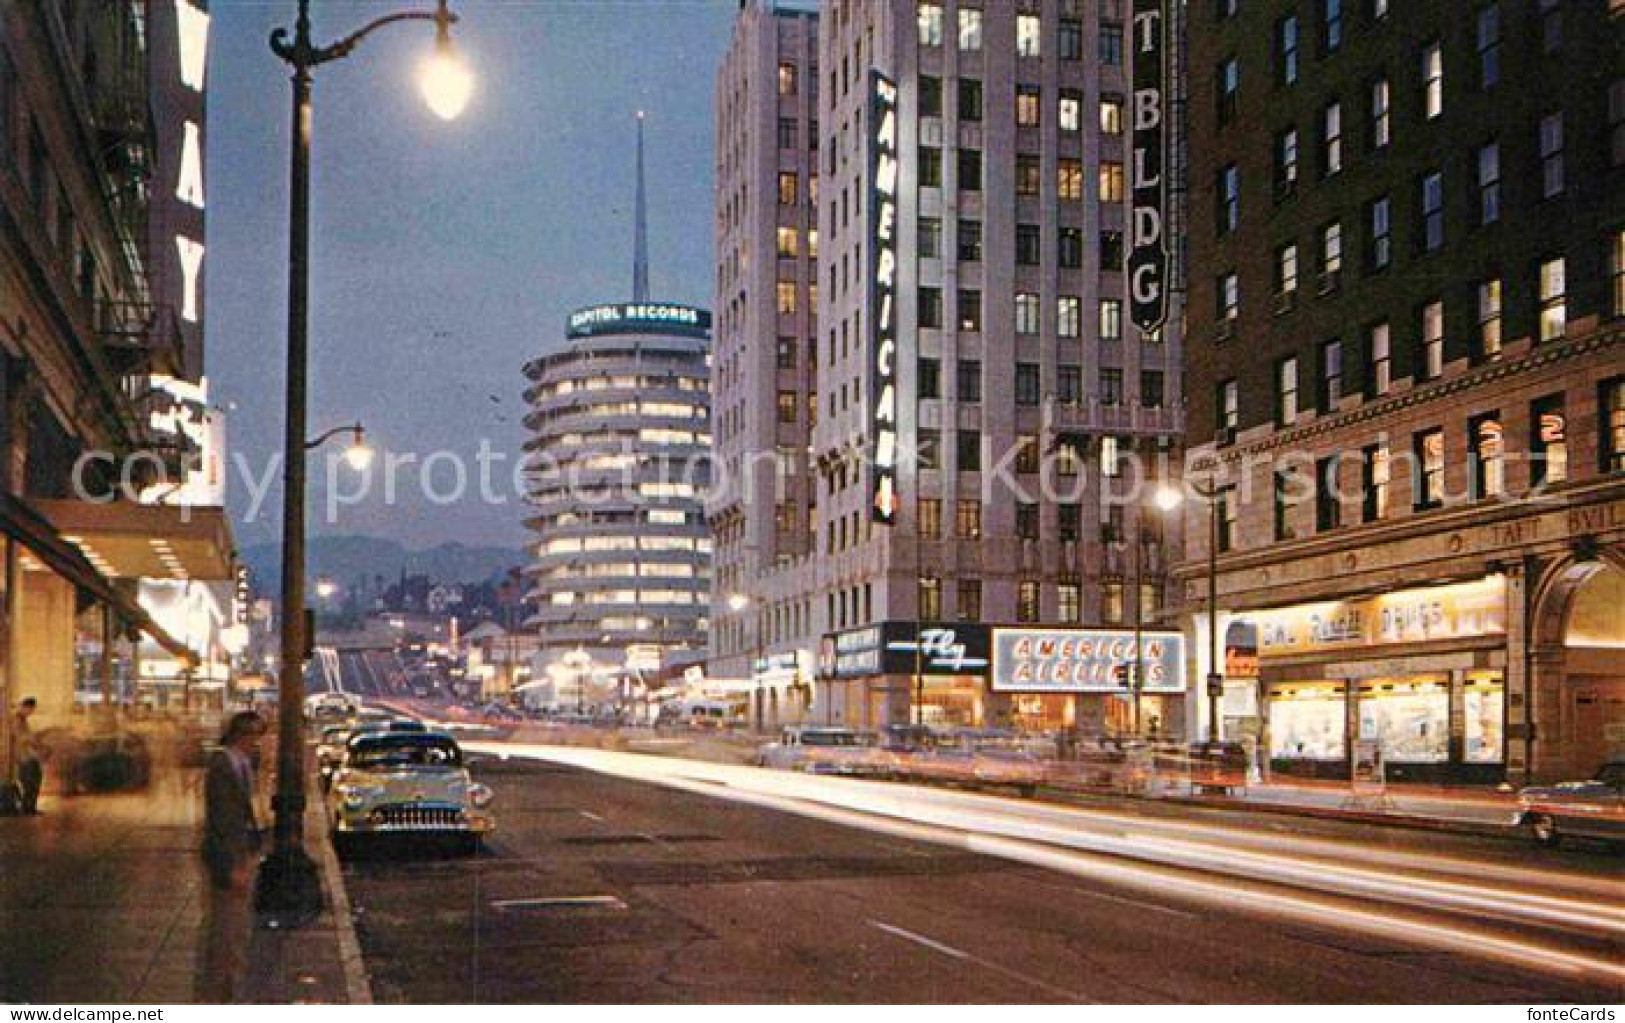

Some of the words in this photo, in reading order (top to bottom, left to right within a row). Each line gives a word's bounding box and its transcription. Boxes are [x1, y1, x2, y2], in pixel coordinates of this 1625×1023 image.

[1133, 88, 1160, 303] BLDG
[626, 305, 698, 324] RECORDS
[1492, 516, 1541, 545] TAFT
[1013, 635, 1164, 660] AMERICAN
